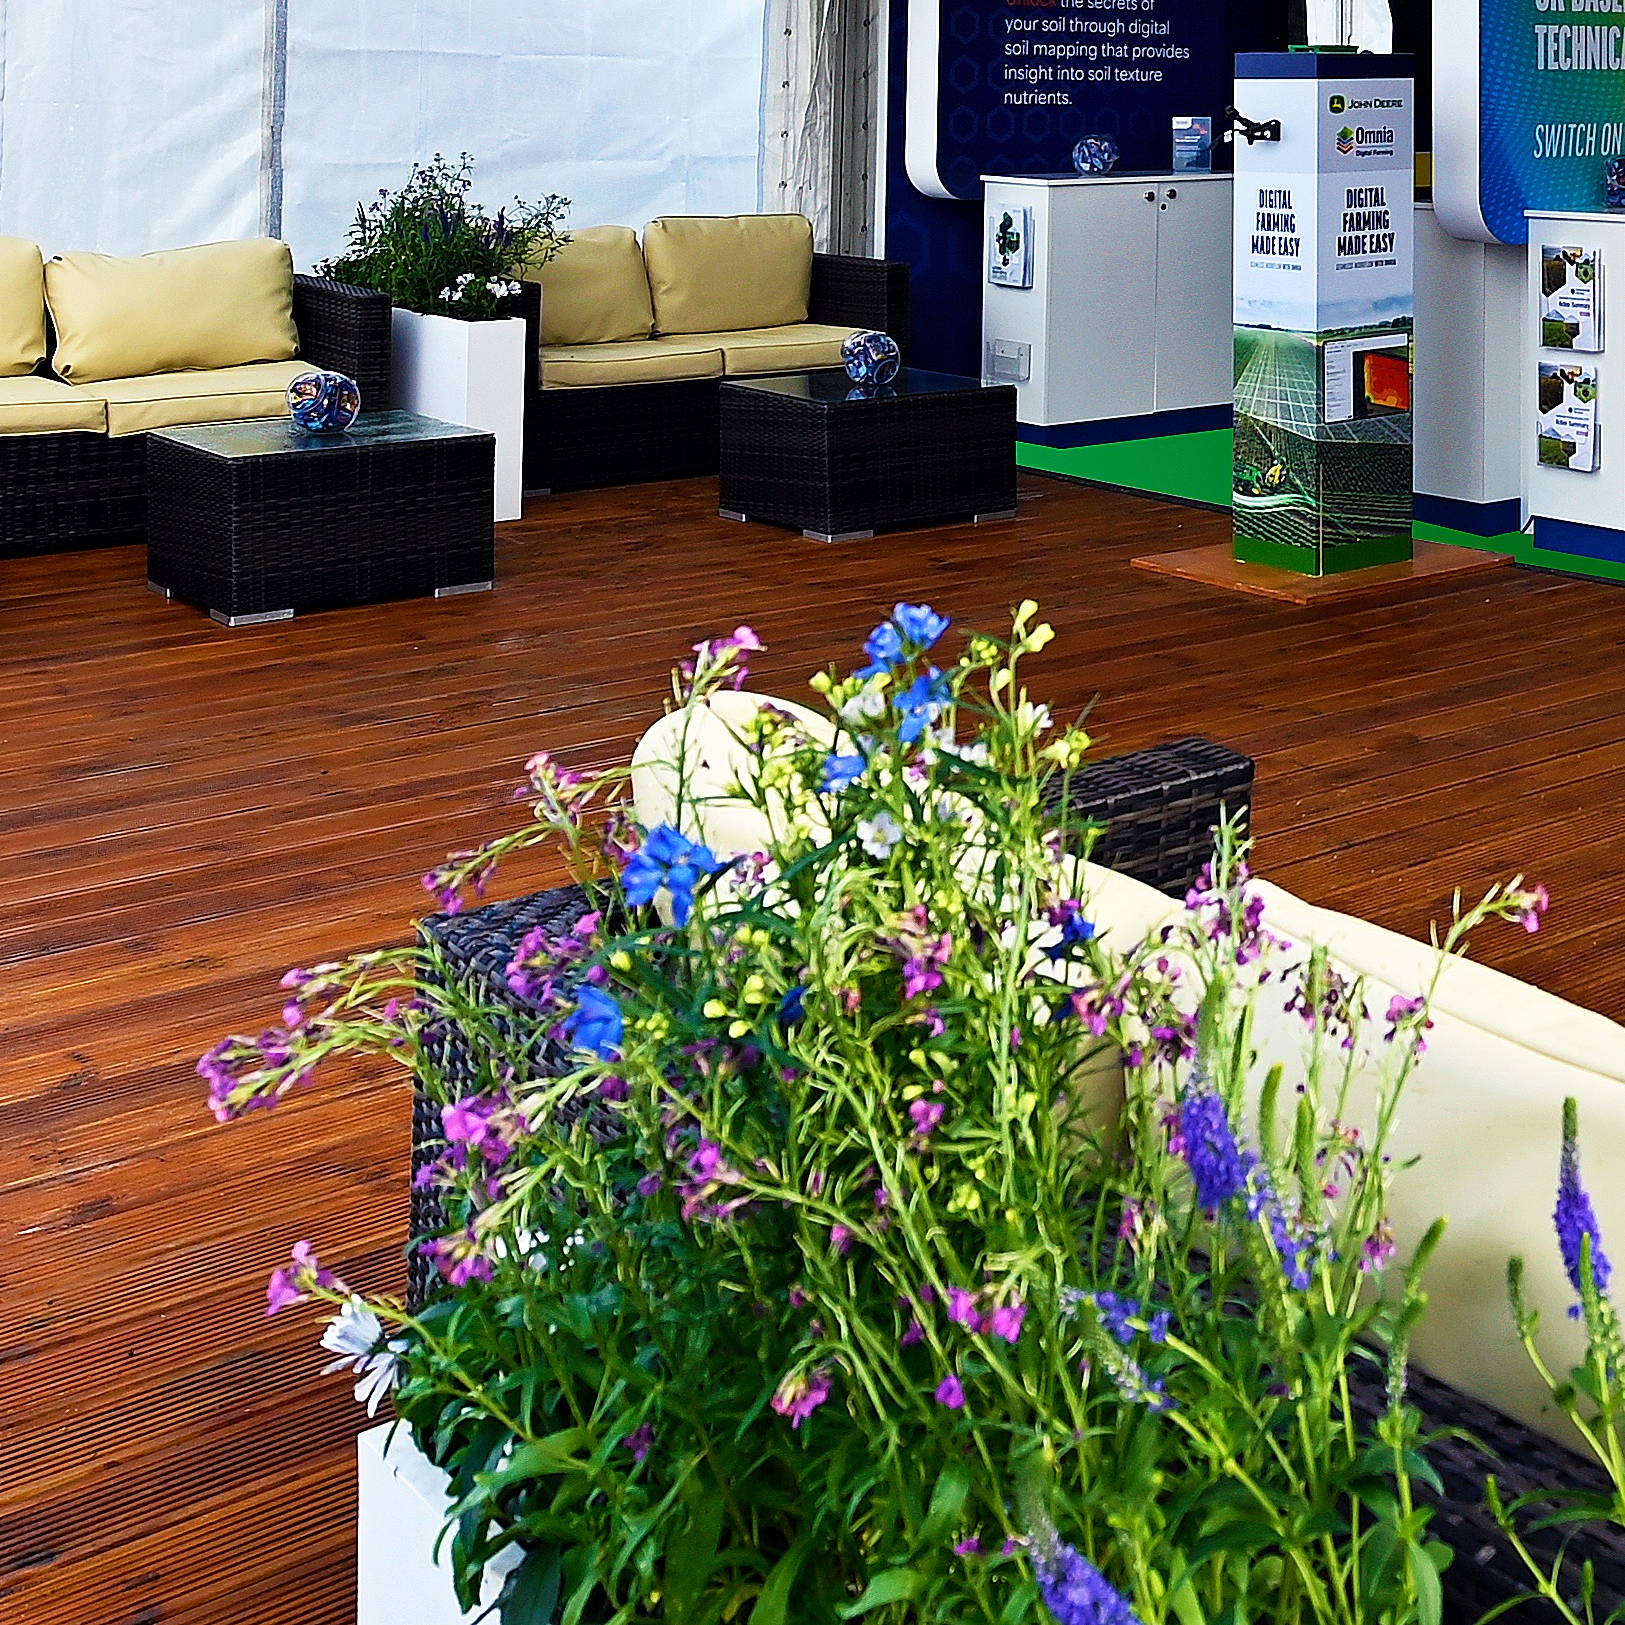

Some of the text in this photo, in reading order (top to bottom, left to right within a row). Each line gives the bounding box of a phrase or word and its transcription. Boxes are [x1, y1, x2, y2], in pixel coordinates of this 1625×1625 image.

[1005, 17, 1170, 38] your soil through digital
[1004, 40, 1190, 61] soil mapping that provides
[1004, 64, 1163, 84] insight into soil texture
[1004, 89, 1073, 105] nutrients.
[1356, 126, 1393, 144] Omnia
[1534, 123, 1597, 158] SWITCH
[1601, 123, 1622, 155] ON
[1259, 189, 1292, 209] DIGITAL
[1346, 187, 1386, 208] DIGITAL
[1256, 212, 1295, 233] FARMING
[1343, 210, 1389, 232] FARMING
[1252, 235, 1300, 257] MADE EASY
[1337, 232, 1395, 256] MADE EASY
